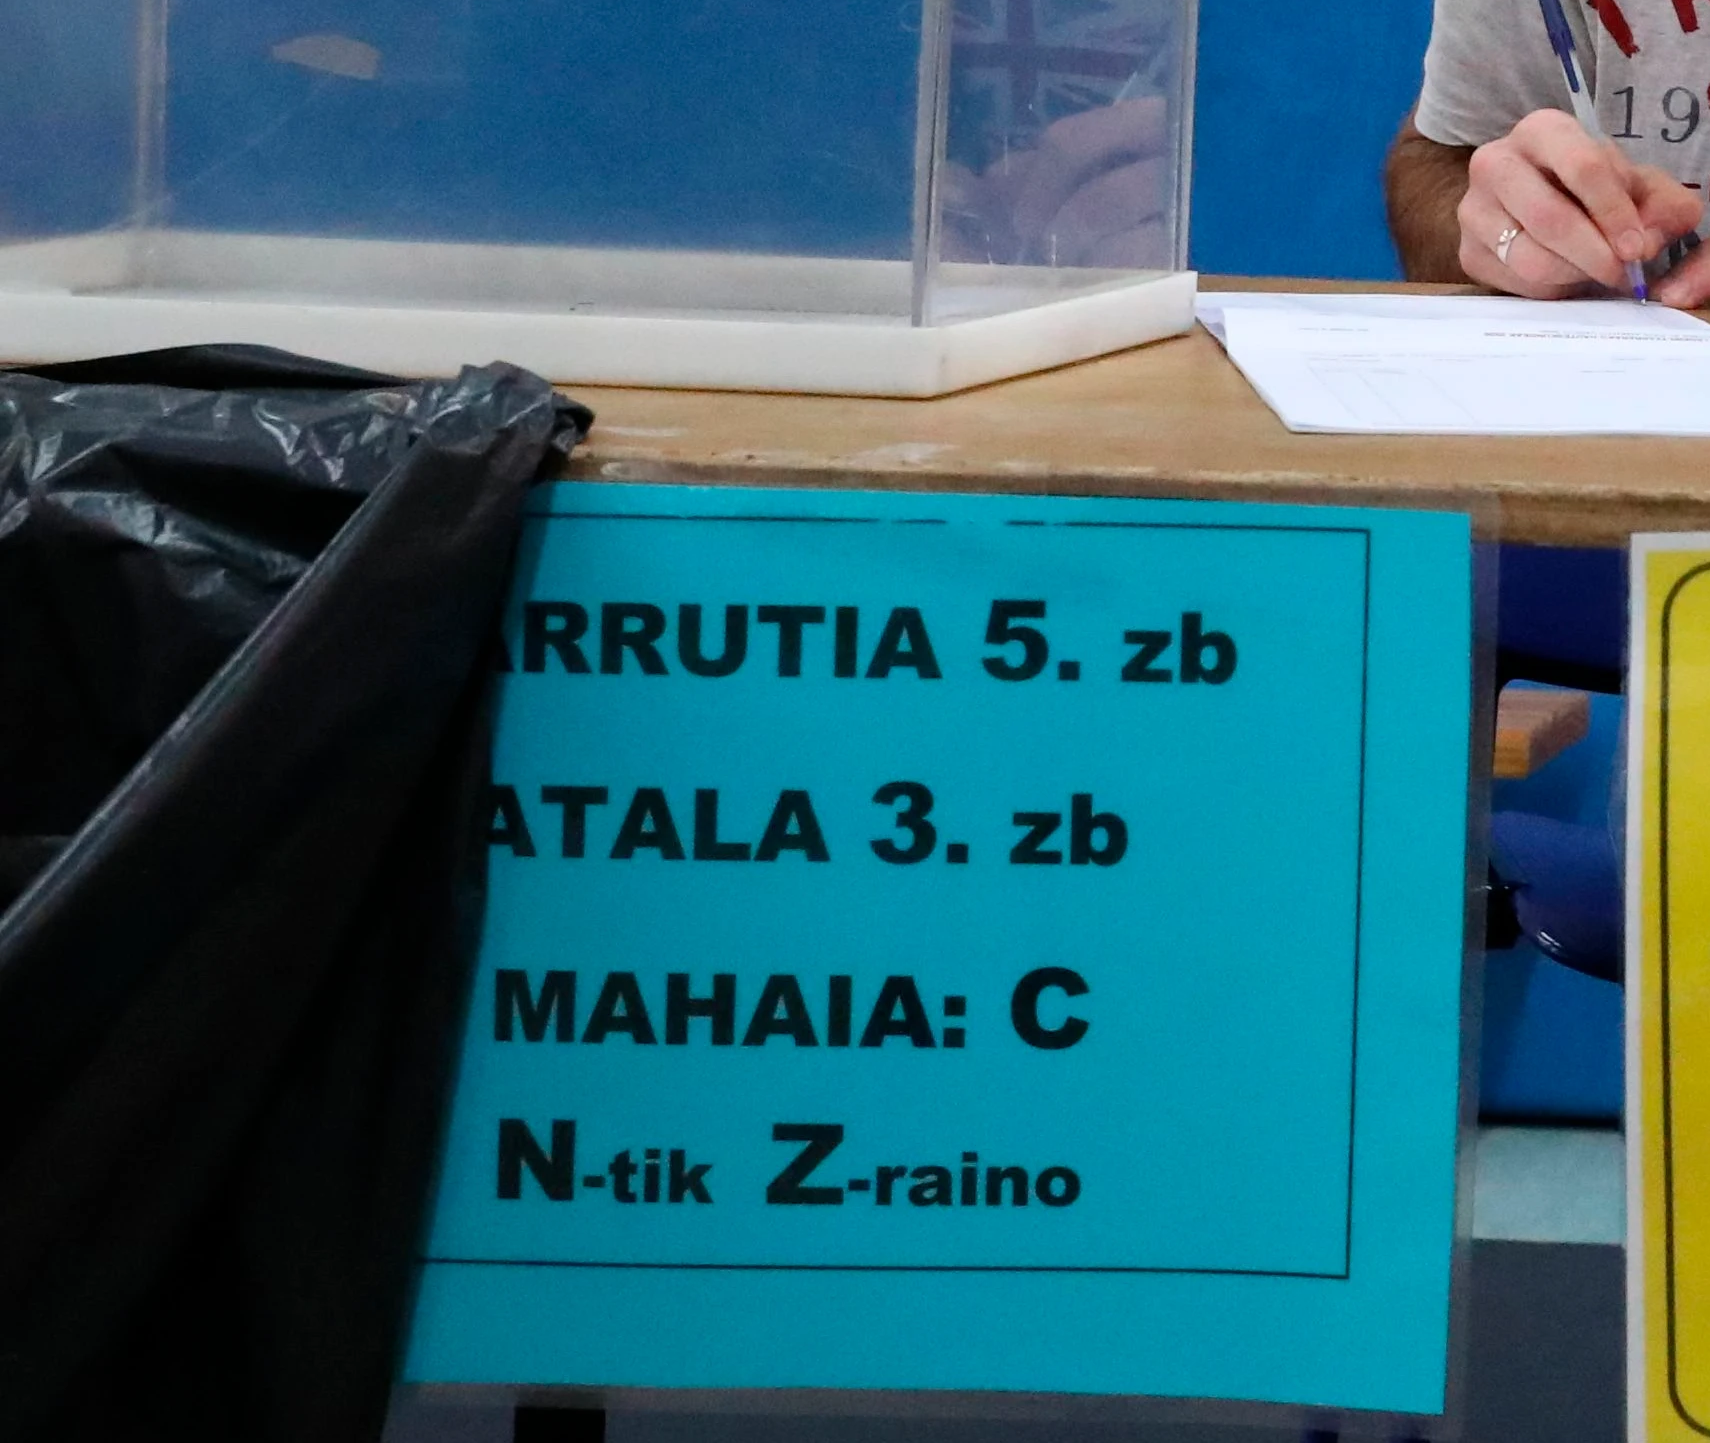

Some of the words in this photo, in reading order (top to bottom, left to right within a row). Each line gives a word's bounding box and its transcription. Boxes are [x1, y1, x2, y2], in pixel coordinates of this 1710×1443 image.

[1611, 85, 1700, 142] 19
[495, 601, 941, 680] RRUTIA
[983, 600, 1080, 681] 5.
[1122, 612, 1237, 684] zb
[488, 784, 829, 862] ATALA
[871, 781, 968, 864] 3.
[1010, 794, 1128, 866] zb
[494, 969, 965, 1048] MAHAIA:
[1011, 967, 1089, 1049] C
[497, 1118, 712, 1203] N-tik
[766, 1123, 1080, 1207] Z-raino
